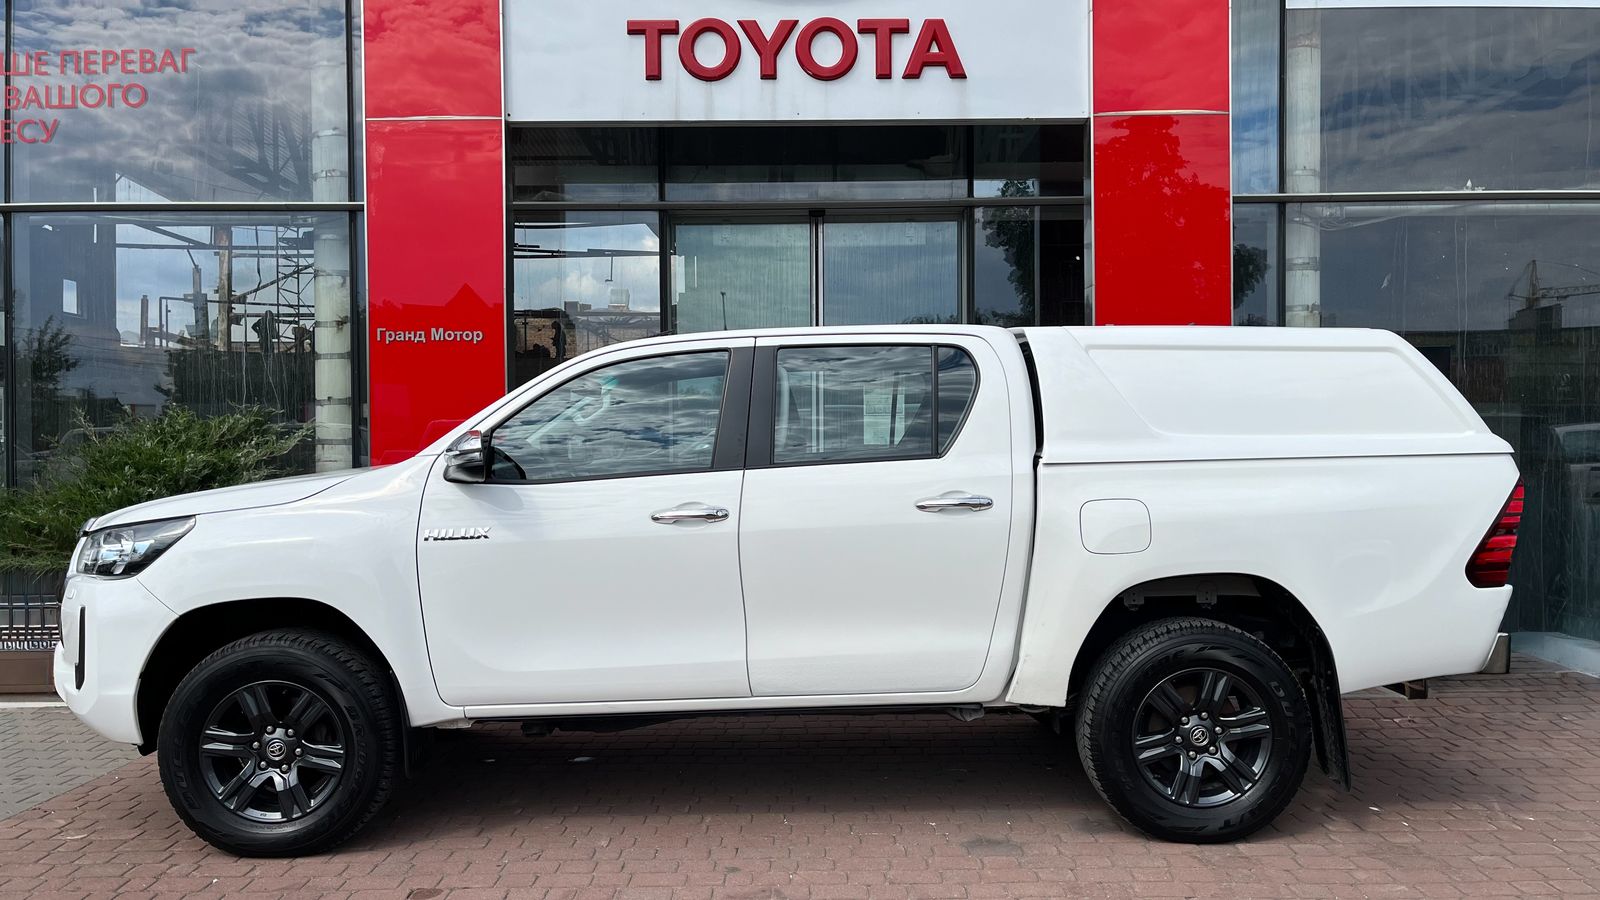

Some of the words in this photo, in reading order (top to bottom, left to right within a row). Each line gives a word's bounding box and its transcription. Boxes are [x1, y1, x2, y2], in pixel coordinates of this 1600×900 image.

[60, 48, 196, 75] ПЕРЕВАГ
[626, 17, 968, 81] TOYOTA
[4, 83, 148, 110] ВАШОГО
[0, 118, 59, 144] ЕСУ
[376, 327, 426, 345] Гранд
[430, 327, 483, 345] Мотор
[423, 527, 491, 541] HILUX
